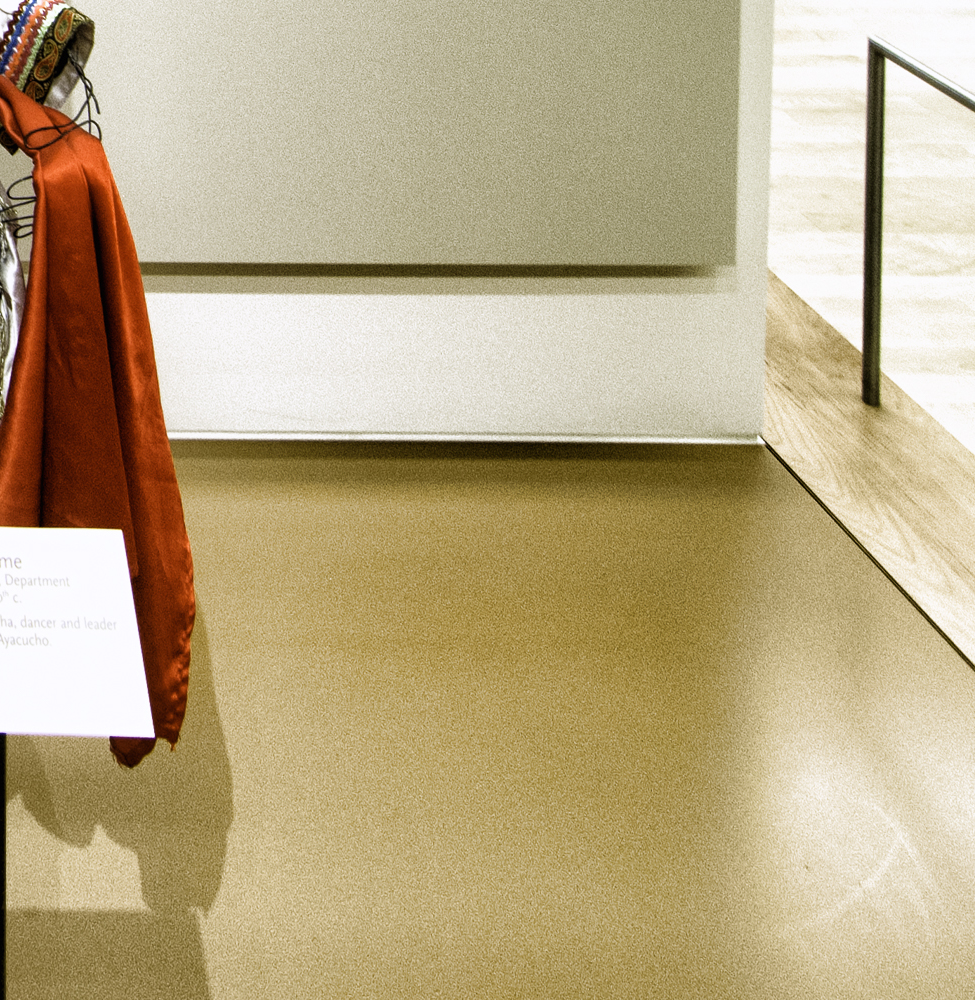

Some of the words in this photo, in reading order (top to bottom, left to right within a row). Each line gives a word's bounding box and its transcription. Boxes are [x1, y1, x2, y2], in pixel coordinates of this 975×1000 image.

[5, 574, 70, 589] Department
[13, 594, 21, 603] c.
[20, 616, 55, 628] dancer
[61, 617, 80, 629] and
[84, 617, 116, 630] leader
